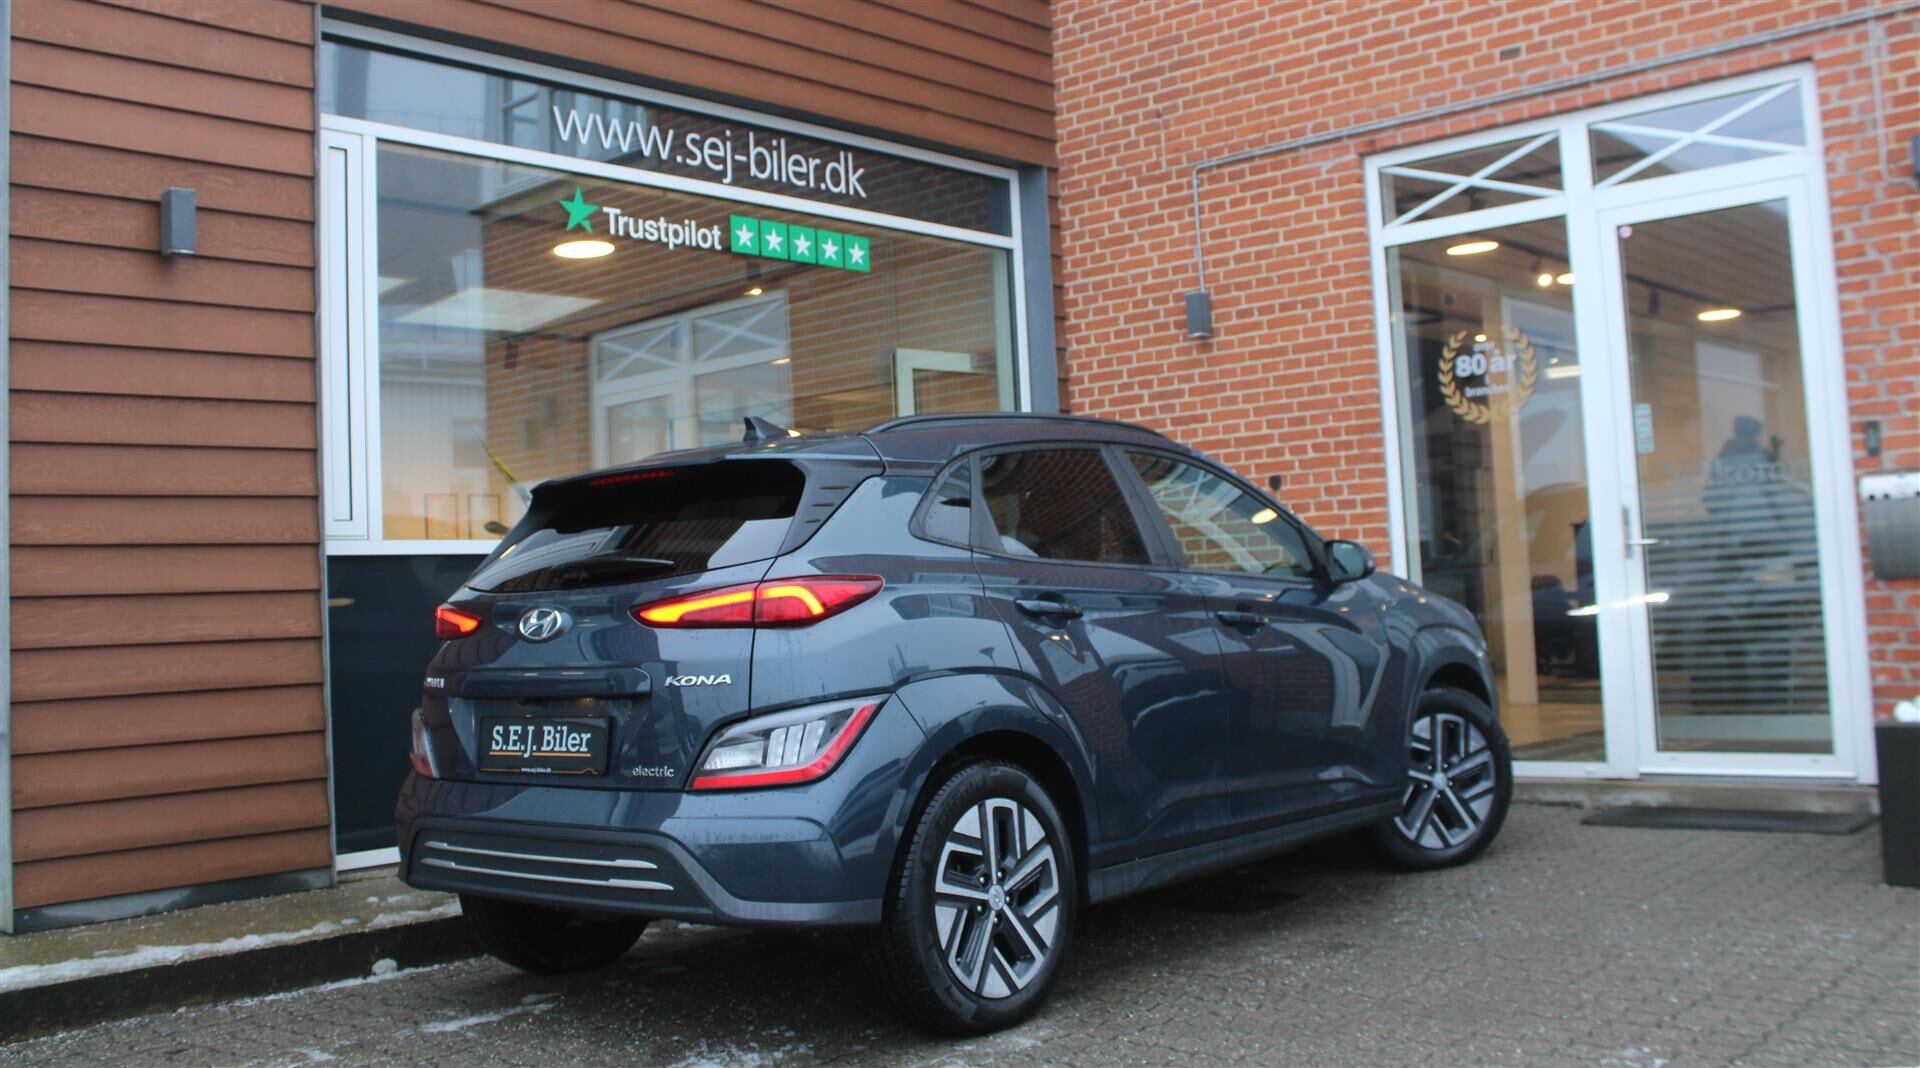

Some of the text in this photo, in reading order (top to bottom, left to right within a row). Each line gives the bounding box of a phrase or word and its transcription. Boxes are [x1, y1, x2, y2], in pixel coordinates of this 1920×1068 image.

[553, 105, 867, 198] www.sej-biler.dk
[602, 206, 722, 251] Trustpilot
[1455, 353, 1487, 378] 80
[664, 674, 732, 687] KONA
[491, 725, 591, 758] S.E.J. Biler
[632, 765, 674, 777] electric
